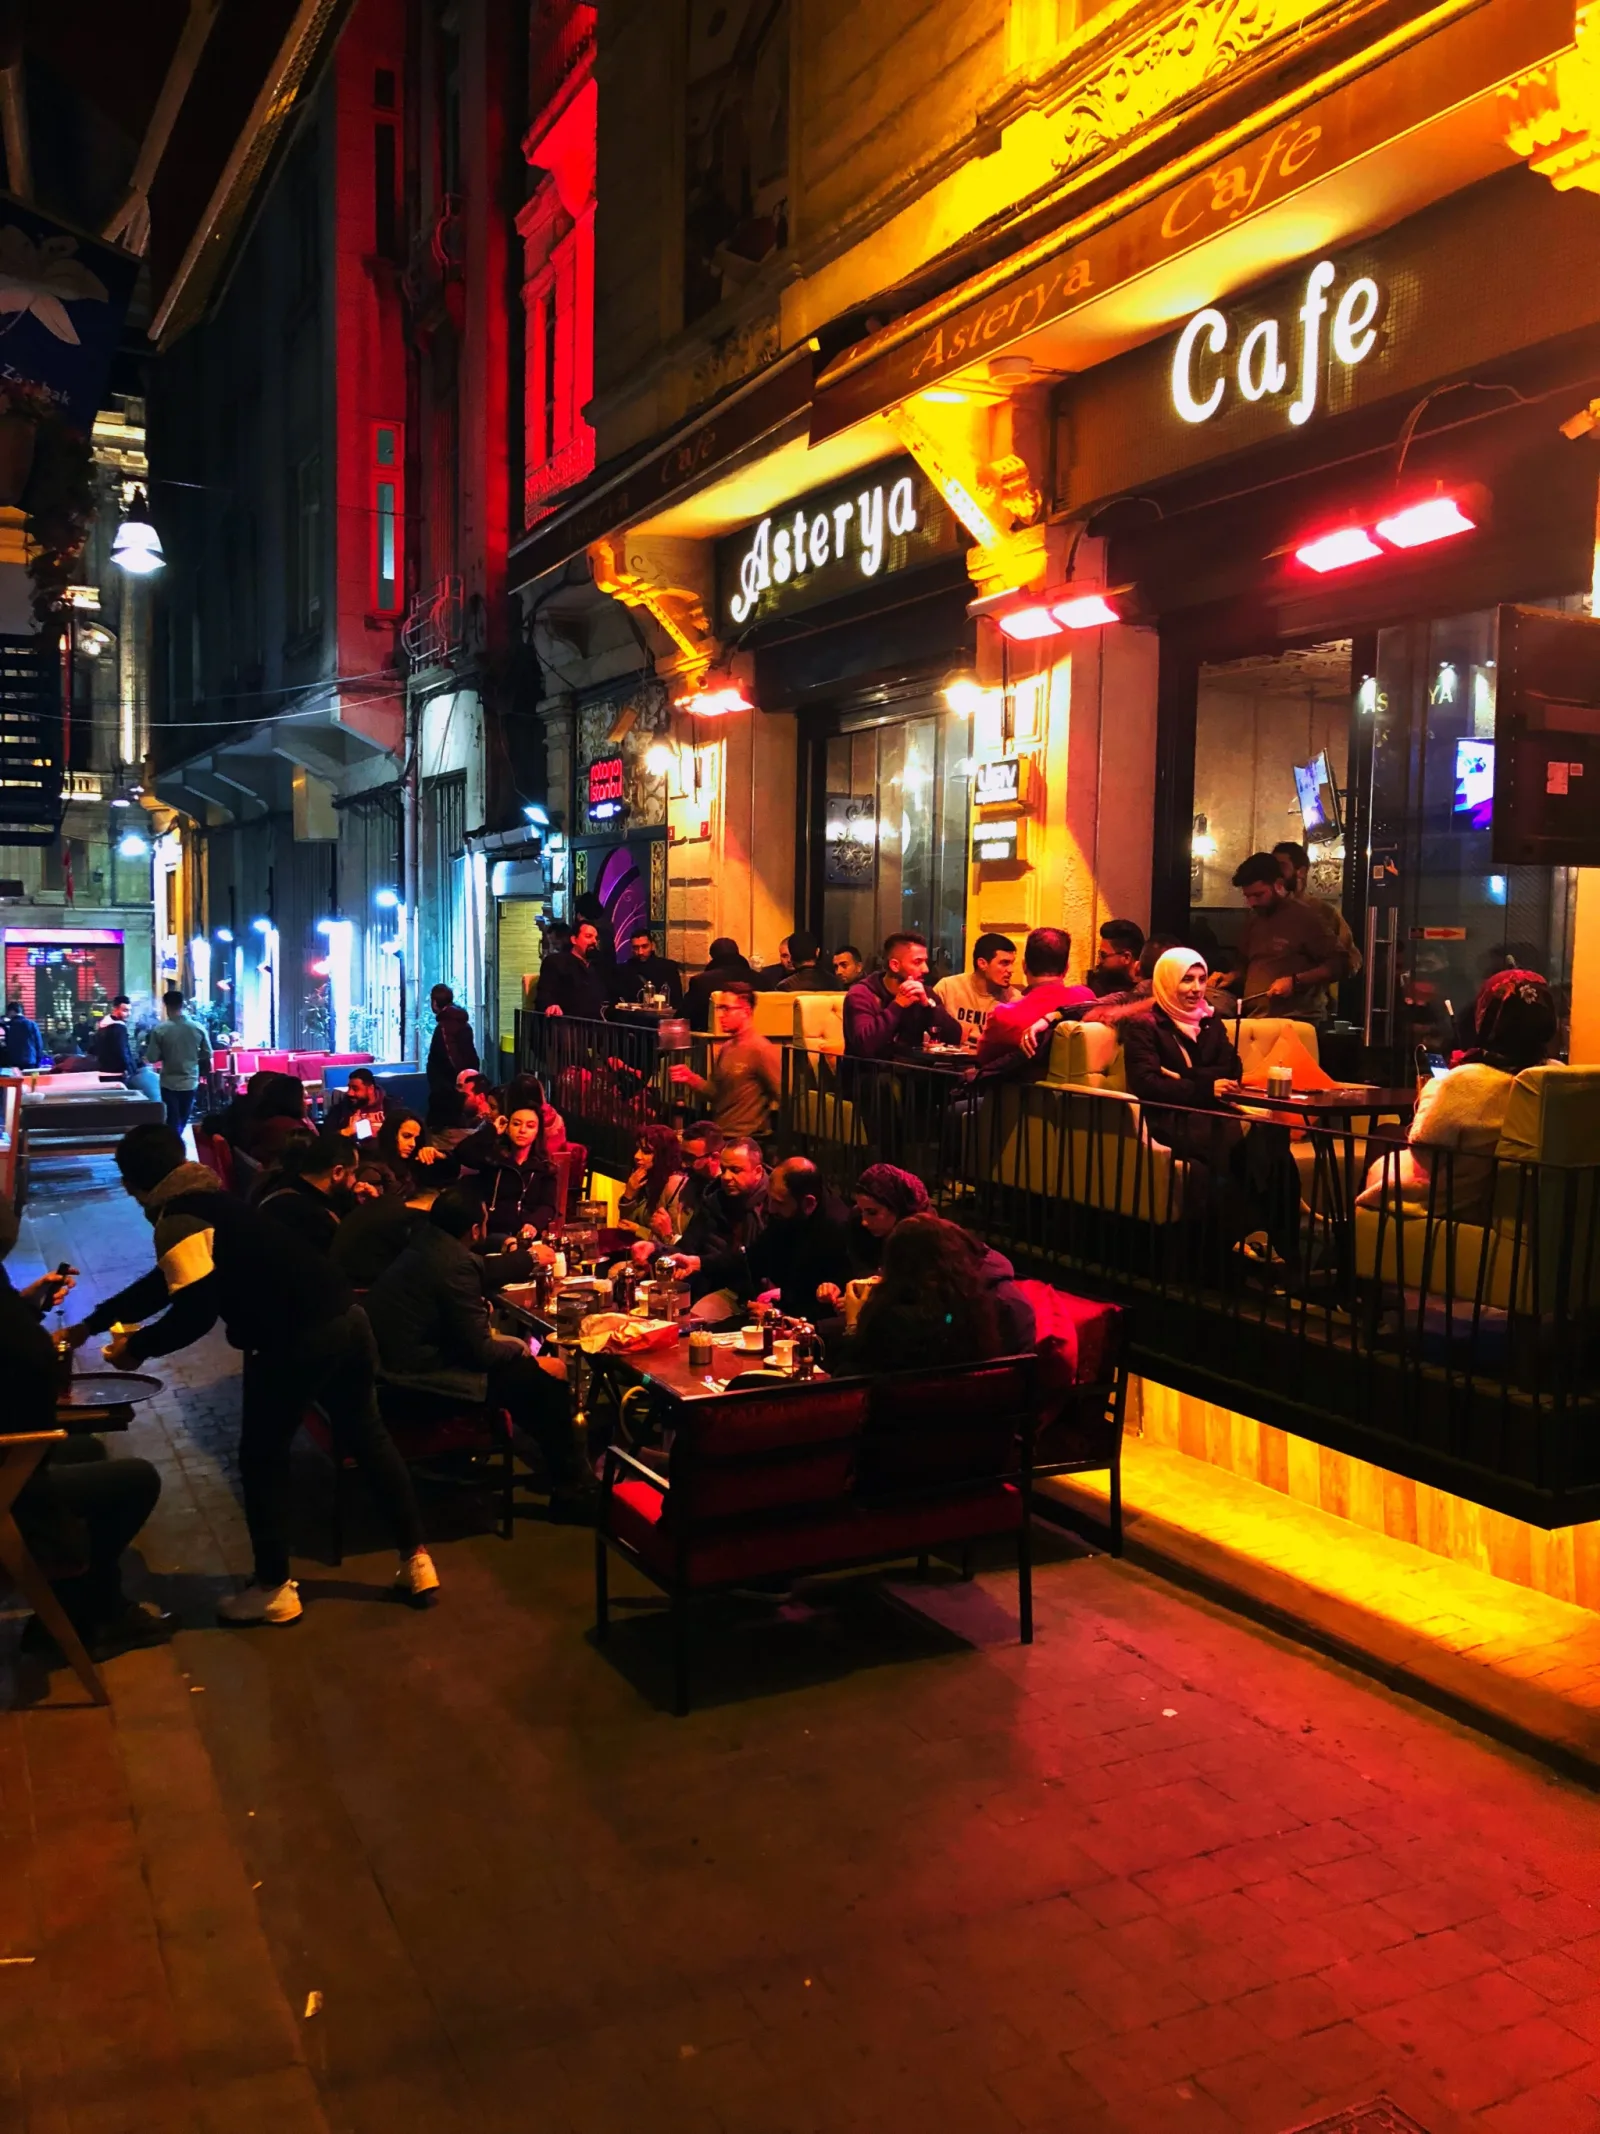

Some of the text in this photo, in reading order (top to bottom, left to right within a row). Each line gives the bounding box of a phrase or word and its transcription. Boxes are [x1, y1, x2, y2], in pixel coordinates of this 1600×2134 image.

[910, 121, 1322, 379] Asterya Cafe
[1, 362, 71, 406] Zabak
[1172, 261, 1379, 425] Cafe
[731, 477, 917, 623] Asterya
[957, 1007, 987, 1026] DENI
